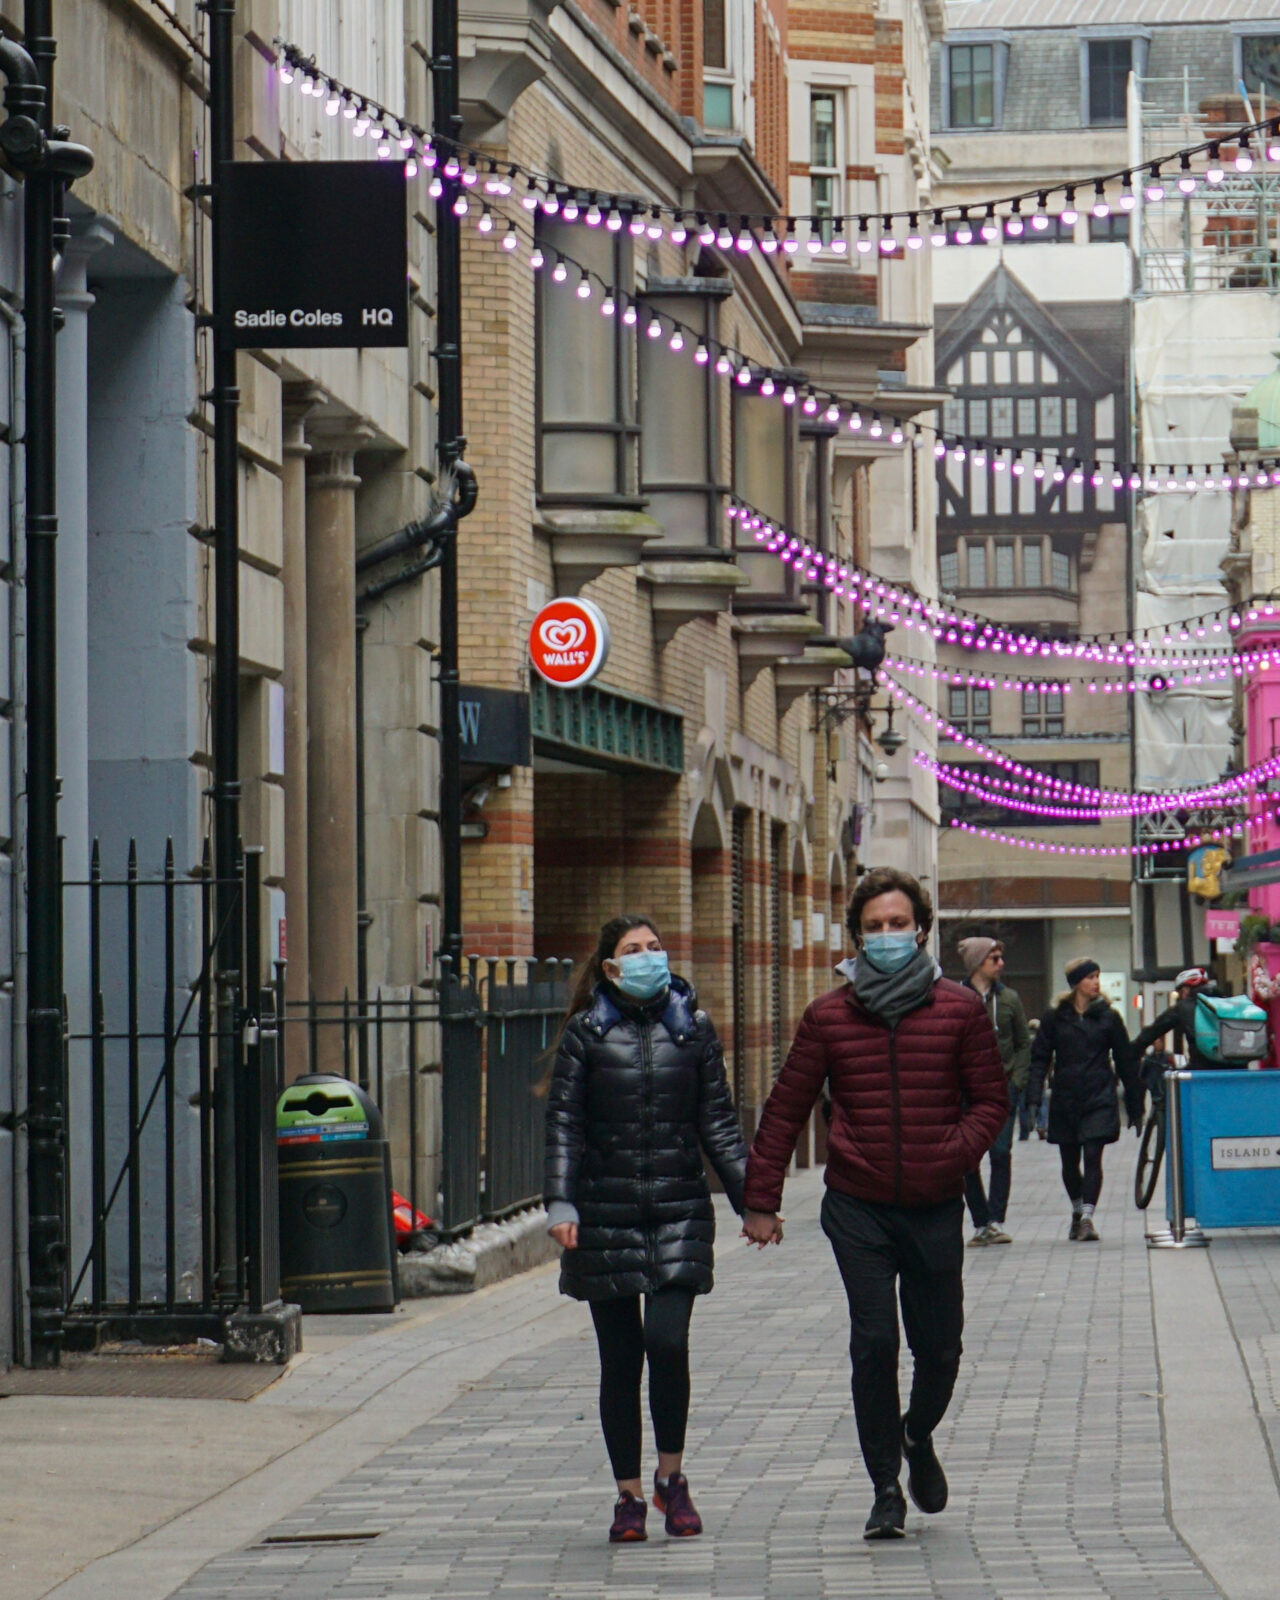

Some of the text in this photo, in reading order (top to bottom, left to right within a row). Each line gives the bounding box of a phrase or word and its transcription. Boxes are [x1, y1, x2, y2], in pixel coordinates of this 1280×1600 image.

[235, 308, 394, 327] Sadie Coles HQ
[543, 651, 585, 667] WALL'S
[1220, 1147, 1271, 1158] ISLAND
